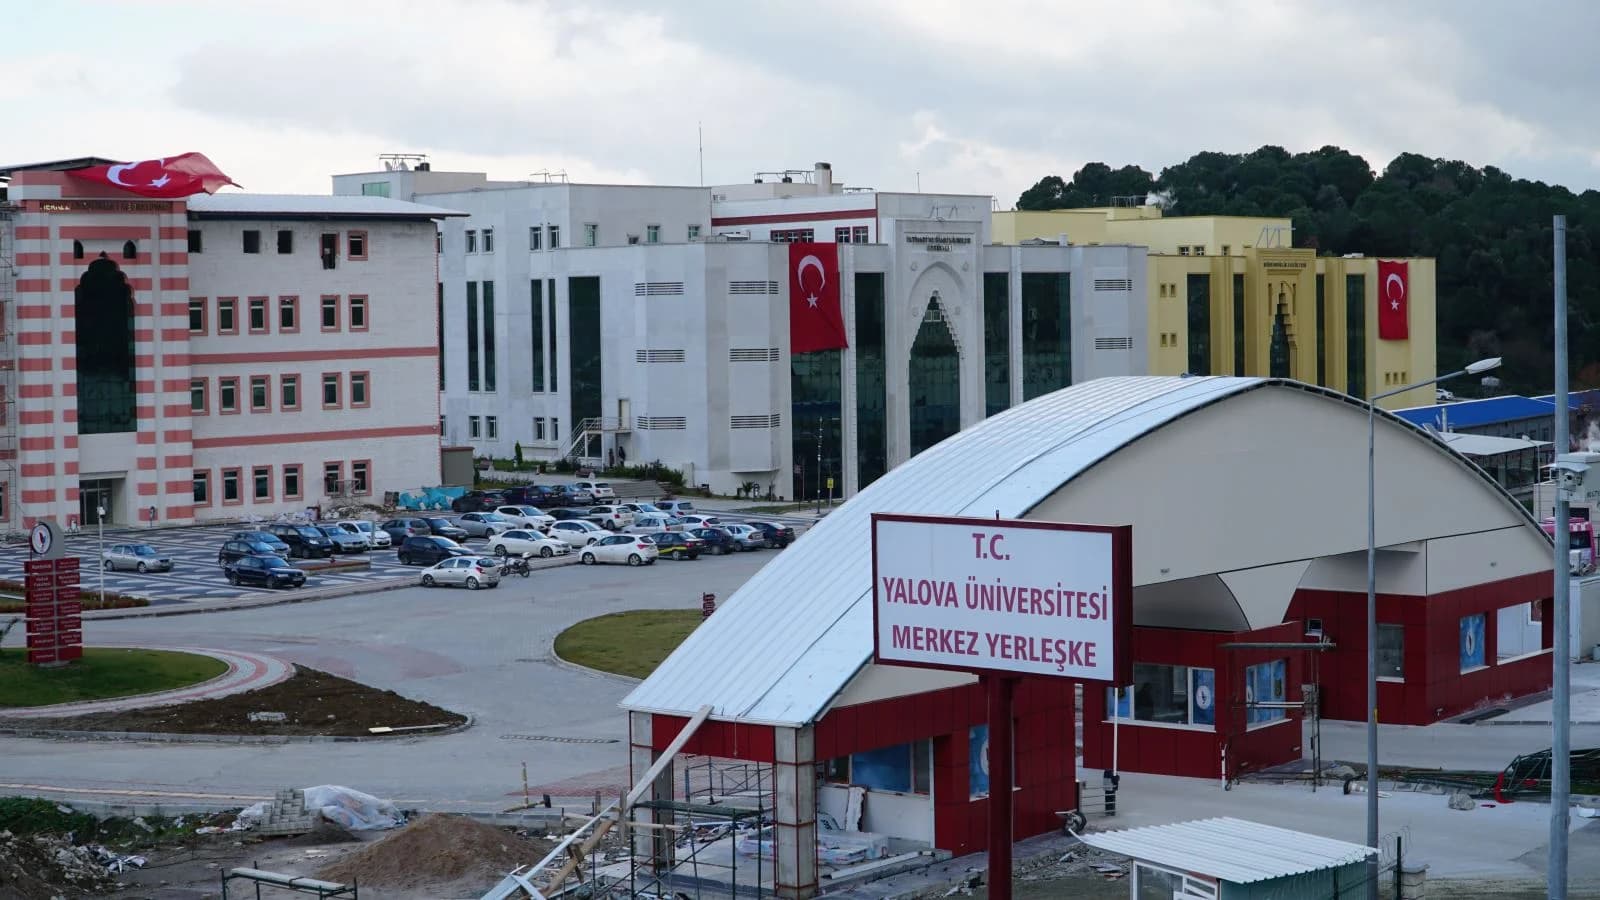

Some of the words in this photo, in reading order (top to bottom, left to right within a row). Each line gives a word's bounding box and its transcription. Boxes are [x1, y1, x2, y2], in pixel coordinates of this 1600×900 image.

[972, 533, 1010, 560] T.C.
[882, 576, 959, 608] YALOVA
[966, 575, 1108, 620] ÜNİVERSİTESİ
[892, 624, 979, 656] MERKEZ
[986, 633, 1097, 672] YERLEŞKE
